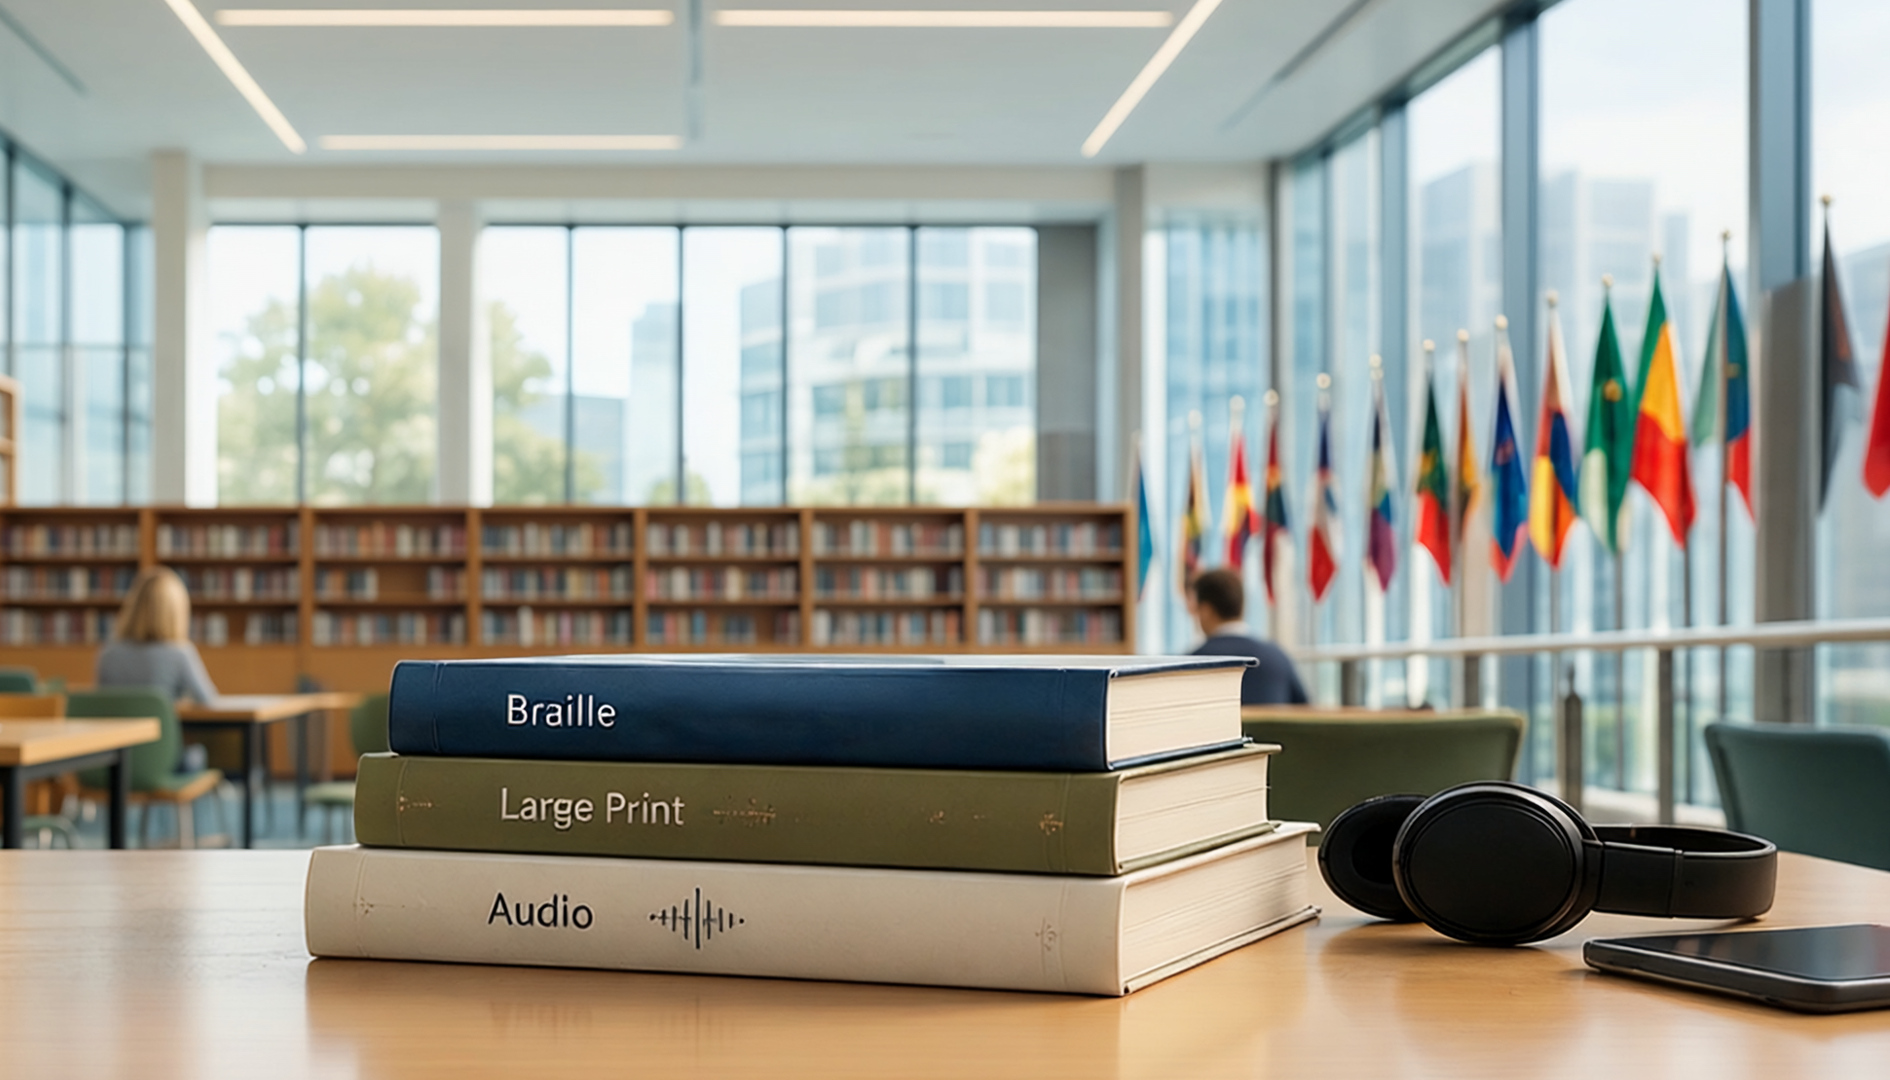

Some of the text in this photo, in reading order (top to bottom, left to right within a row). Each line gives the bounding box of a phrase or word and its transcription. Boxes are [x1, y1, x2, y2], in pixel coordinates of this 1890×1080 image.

[506, 693, 617, 728] Braille
[501, 787, 685, 829] Large Print
[487, 891, 594, 930] Audio
